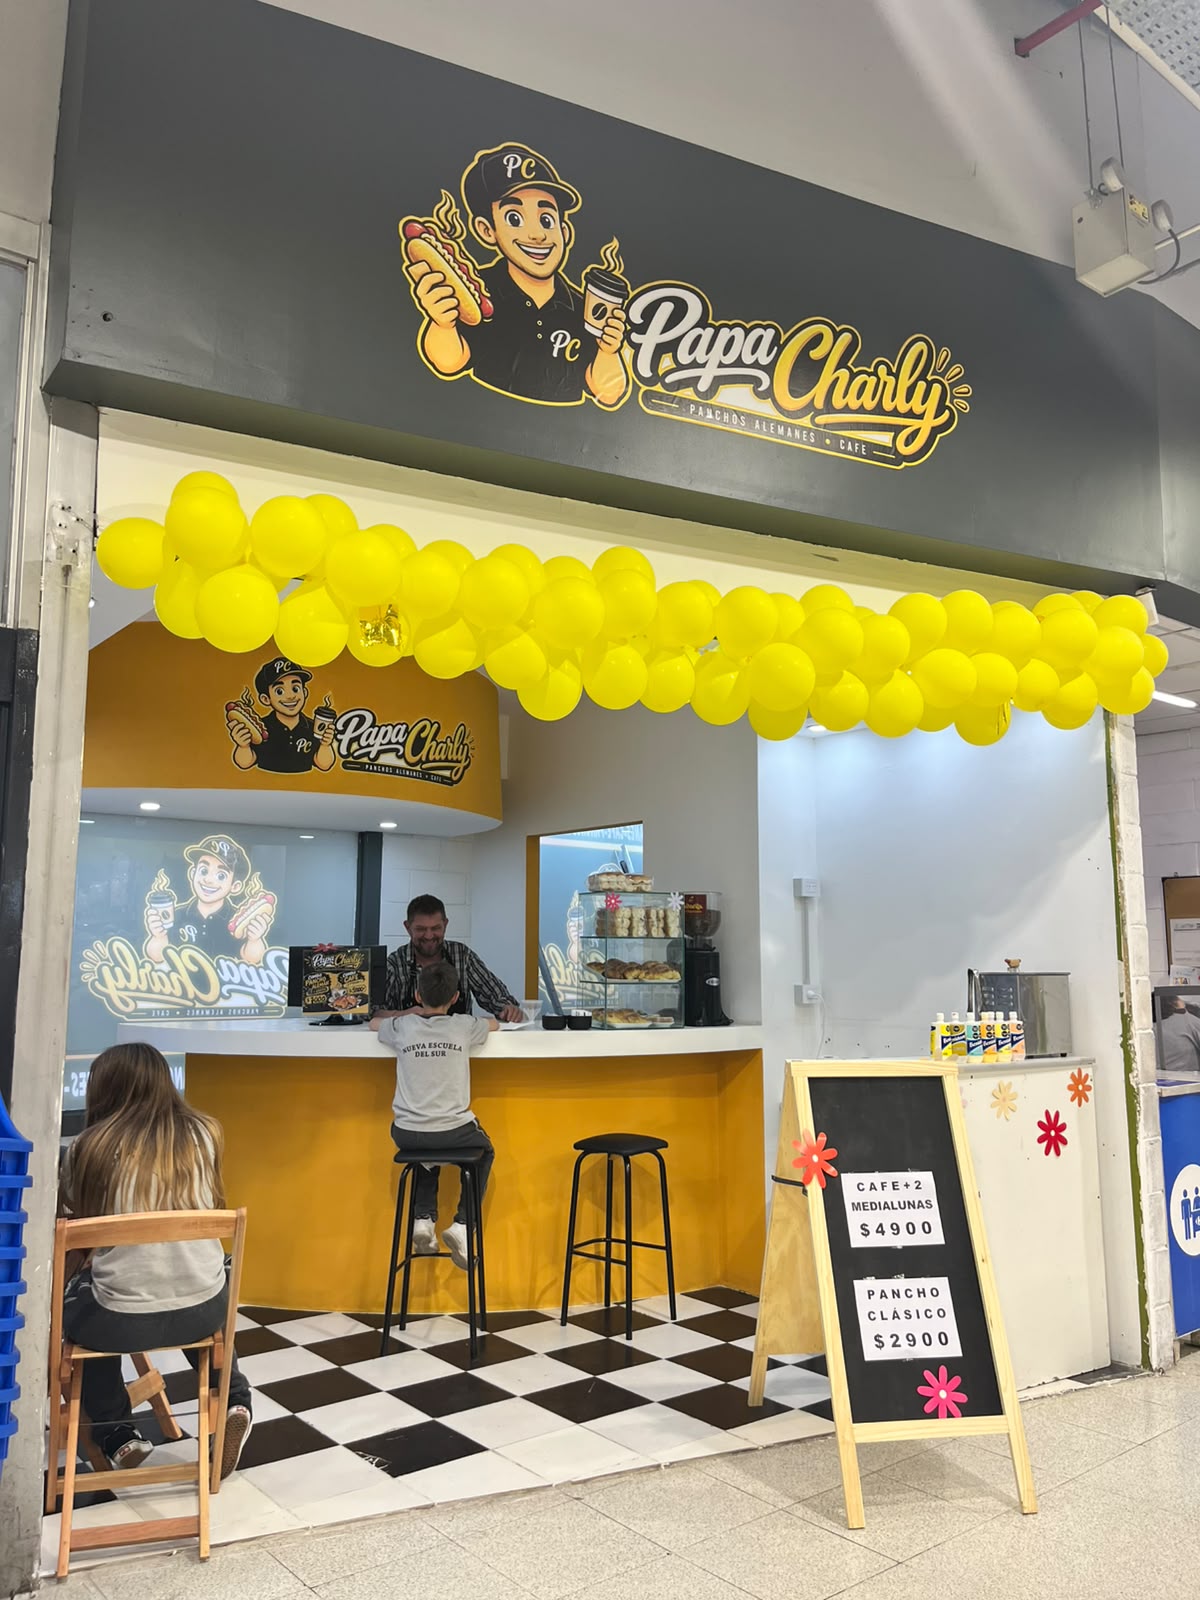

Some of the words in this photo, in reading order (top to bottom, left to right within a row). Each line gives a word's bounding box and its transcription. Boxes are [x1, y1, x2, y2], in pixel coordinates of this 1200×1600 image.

[502, 153, 537, 180] PC
[549, 329, 582, 363] PC
[628, 286, 778, 393] Papa
[773, 322, 951, 456] Charly
[689, 403, 747, 427] PANCHOS
[754, 419, 816, 443] ALEMANES
[839, 438, 868, 456] CAFE
[274, 660, 292, 674] PC
[296, 737, 313, 753] PC
[336, 710, 408, 759] Papa
[405, 720, 470, 780] Charly
[402, 1043, 426, 1053] NUEVA
[428, 1042, 462, 1052] ESCUELA
[851, 1199, 934, 1212] MEDIALUNAS
[859, 1220, 933, 1238] $4900
[867, 1286, 941, 1300] PANCHO
[867, 1306, 947, 1321] CLÁSICO
[873, 1330, 950, 1351] $2900
